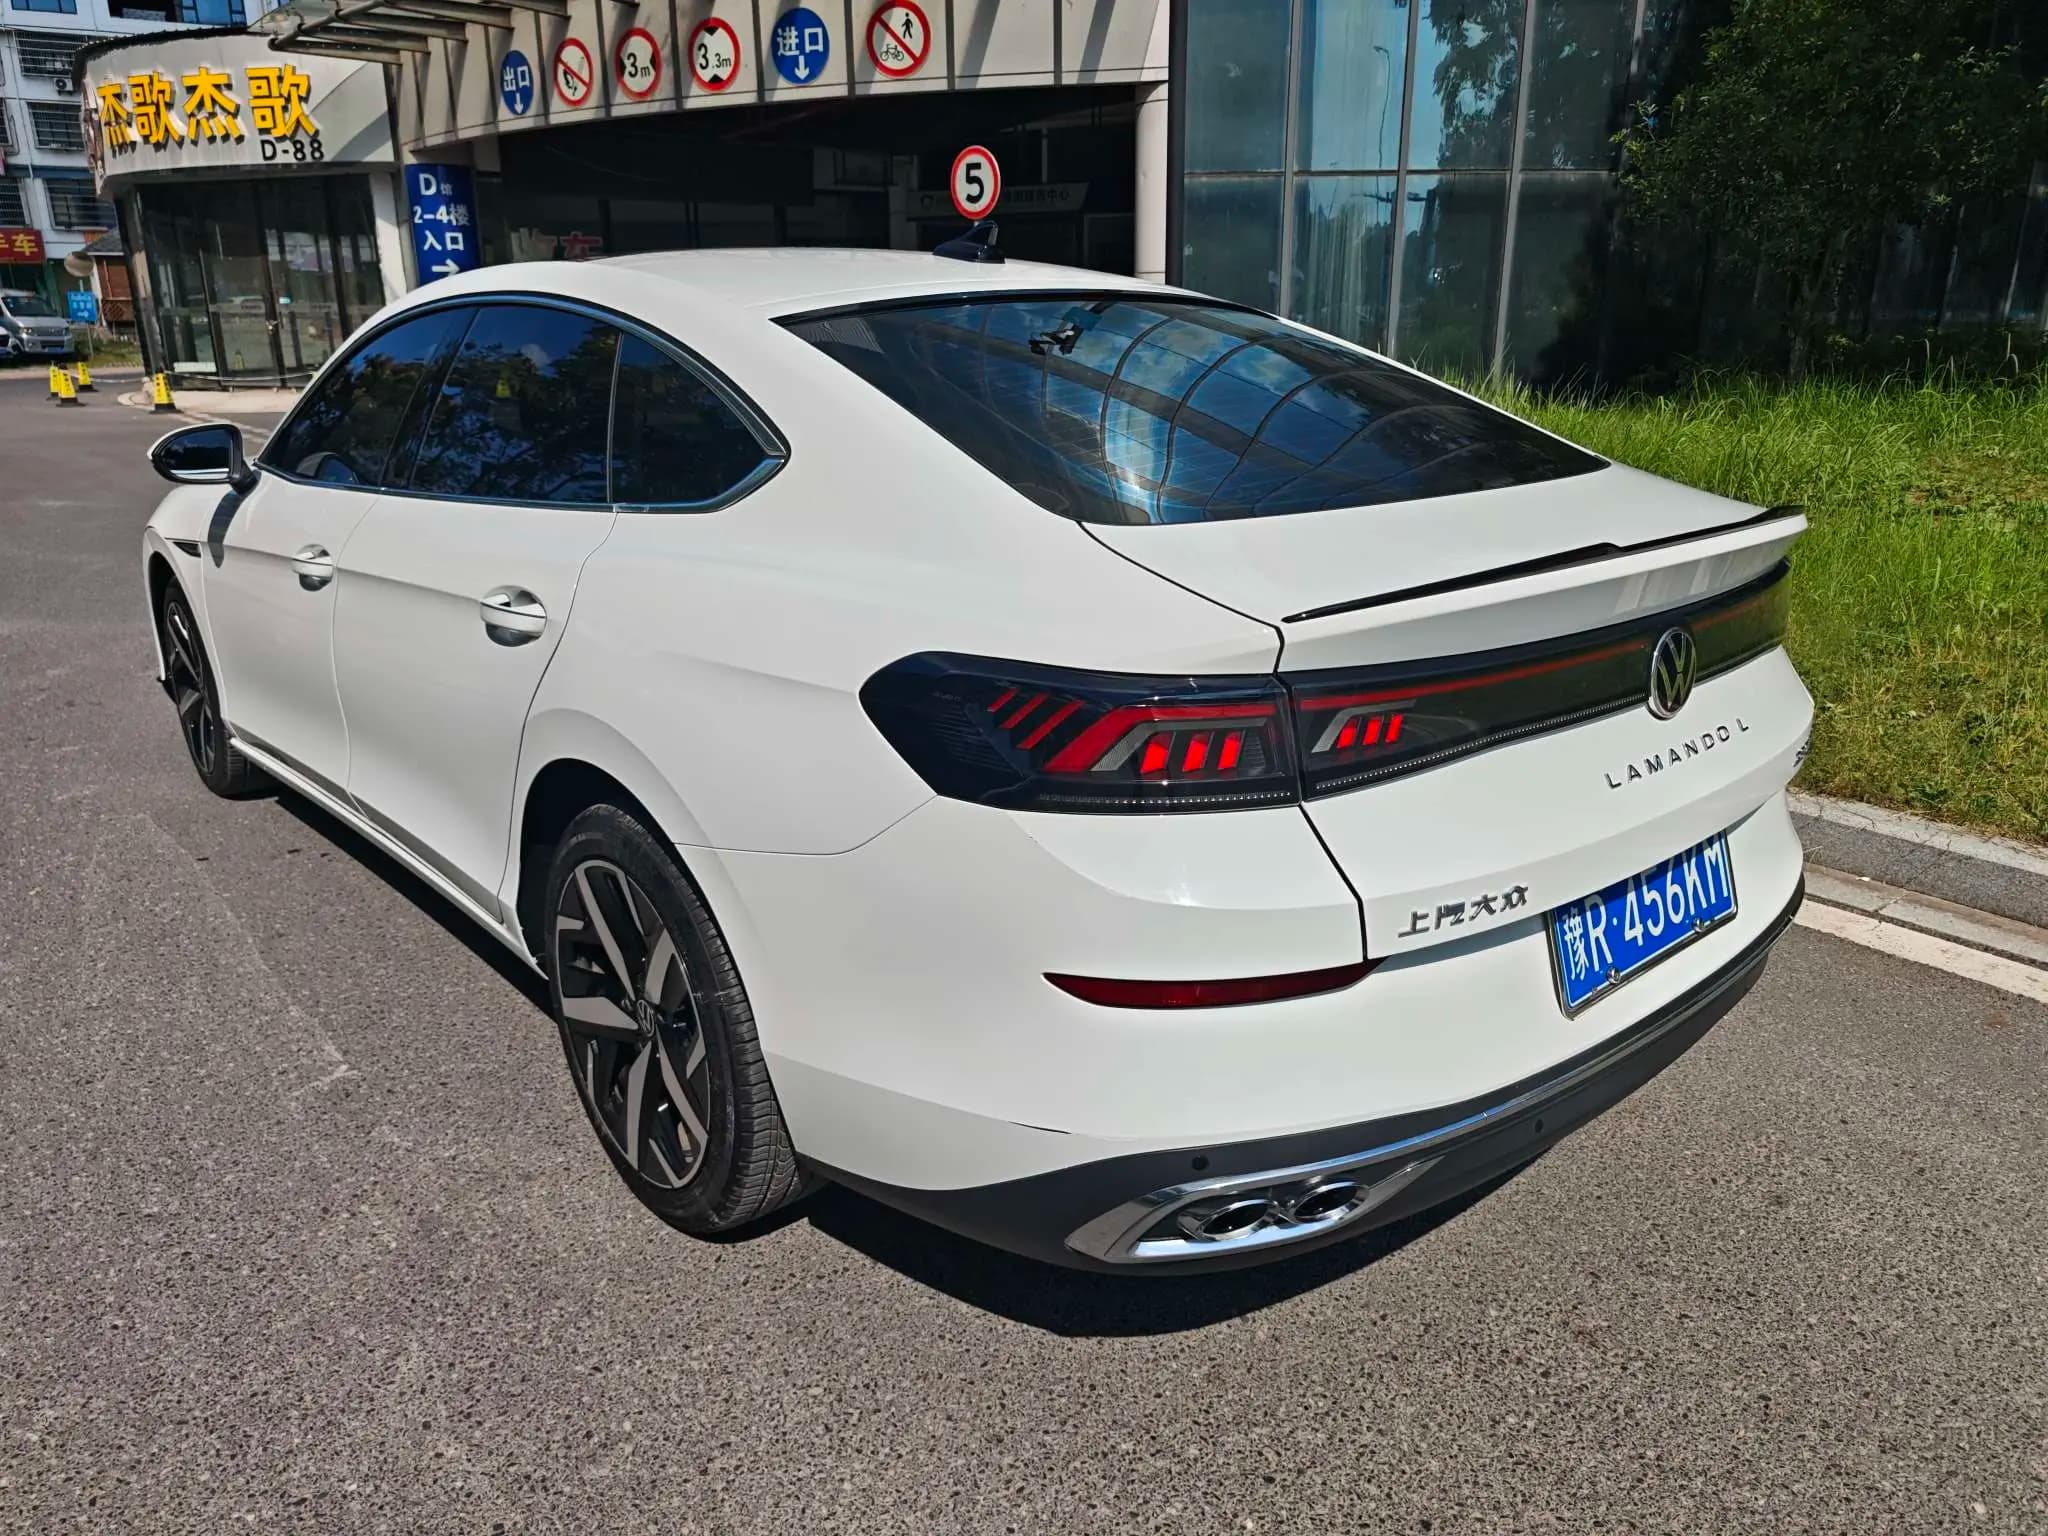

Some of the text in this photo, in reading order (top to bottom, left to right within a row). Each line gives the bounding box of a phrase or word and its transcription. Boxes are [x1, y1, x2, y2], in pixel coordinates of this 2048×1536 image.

[777, 26, 824, 56] 进口
[698, 43, 732, 70] 3.3m
[503, 65, 530, 92] 出口
[96, 63, 319, 147] 杰歌杰歌
[260, 138, 324, 161] D-88
[965, 162, 984, 204] 5
[413, 203, 470, 226] 2-4楼
[423, 230, 464, 250] 入口
[1604, 718, 1749, 789] LAMANDO L
[1398, 885, 1528, 938] 上汽大众
